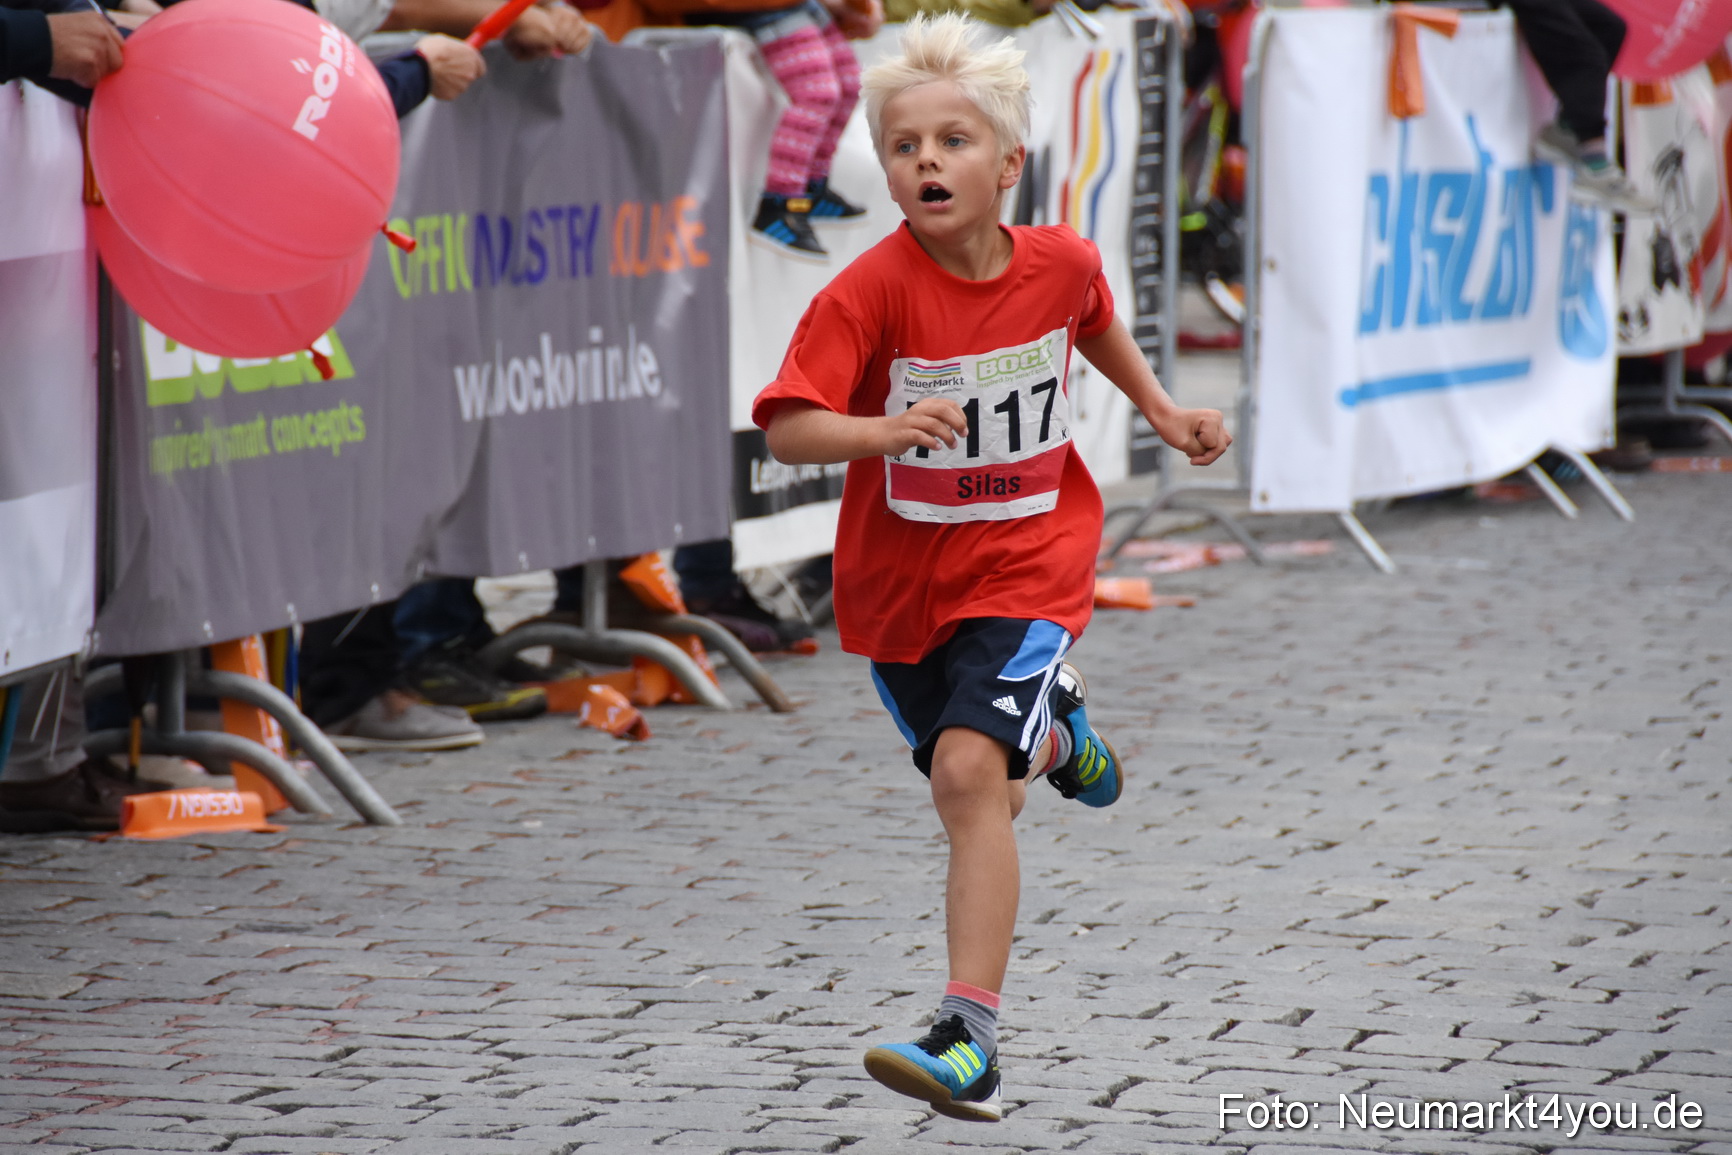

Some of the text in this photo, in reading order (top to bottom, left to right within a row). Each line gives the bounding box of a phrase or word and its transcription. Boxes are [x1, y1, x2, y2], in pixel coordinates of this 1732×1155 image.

[976, 339, 1053, 381] BOCK
[903, 376, 964, 388] NeuerMarkt
[957, 473, 1021, 499] Silas
